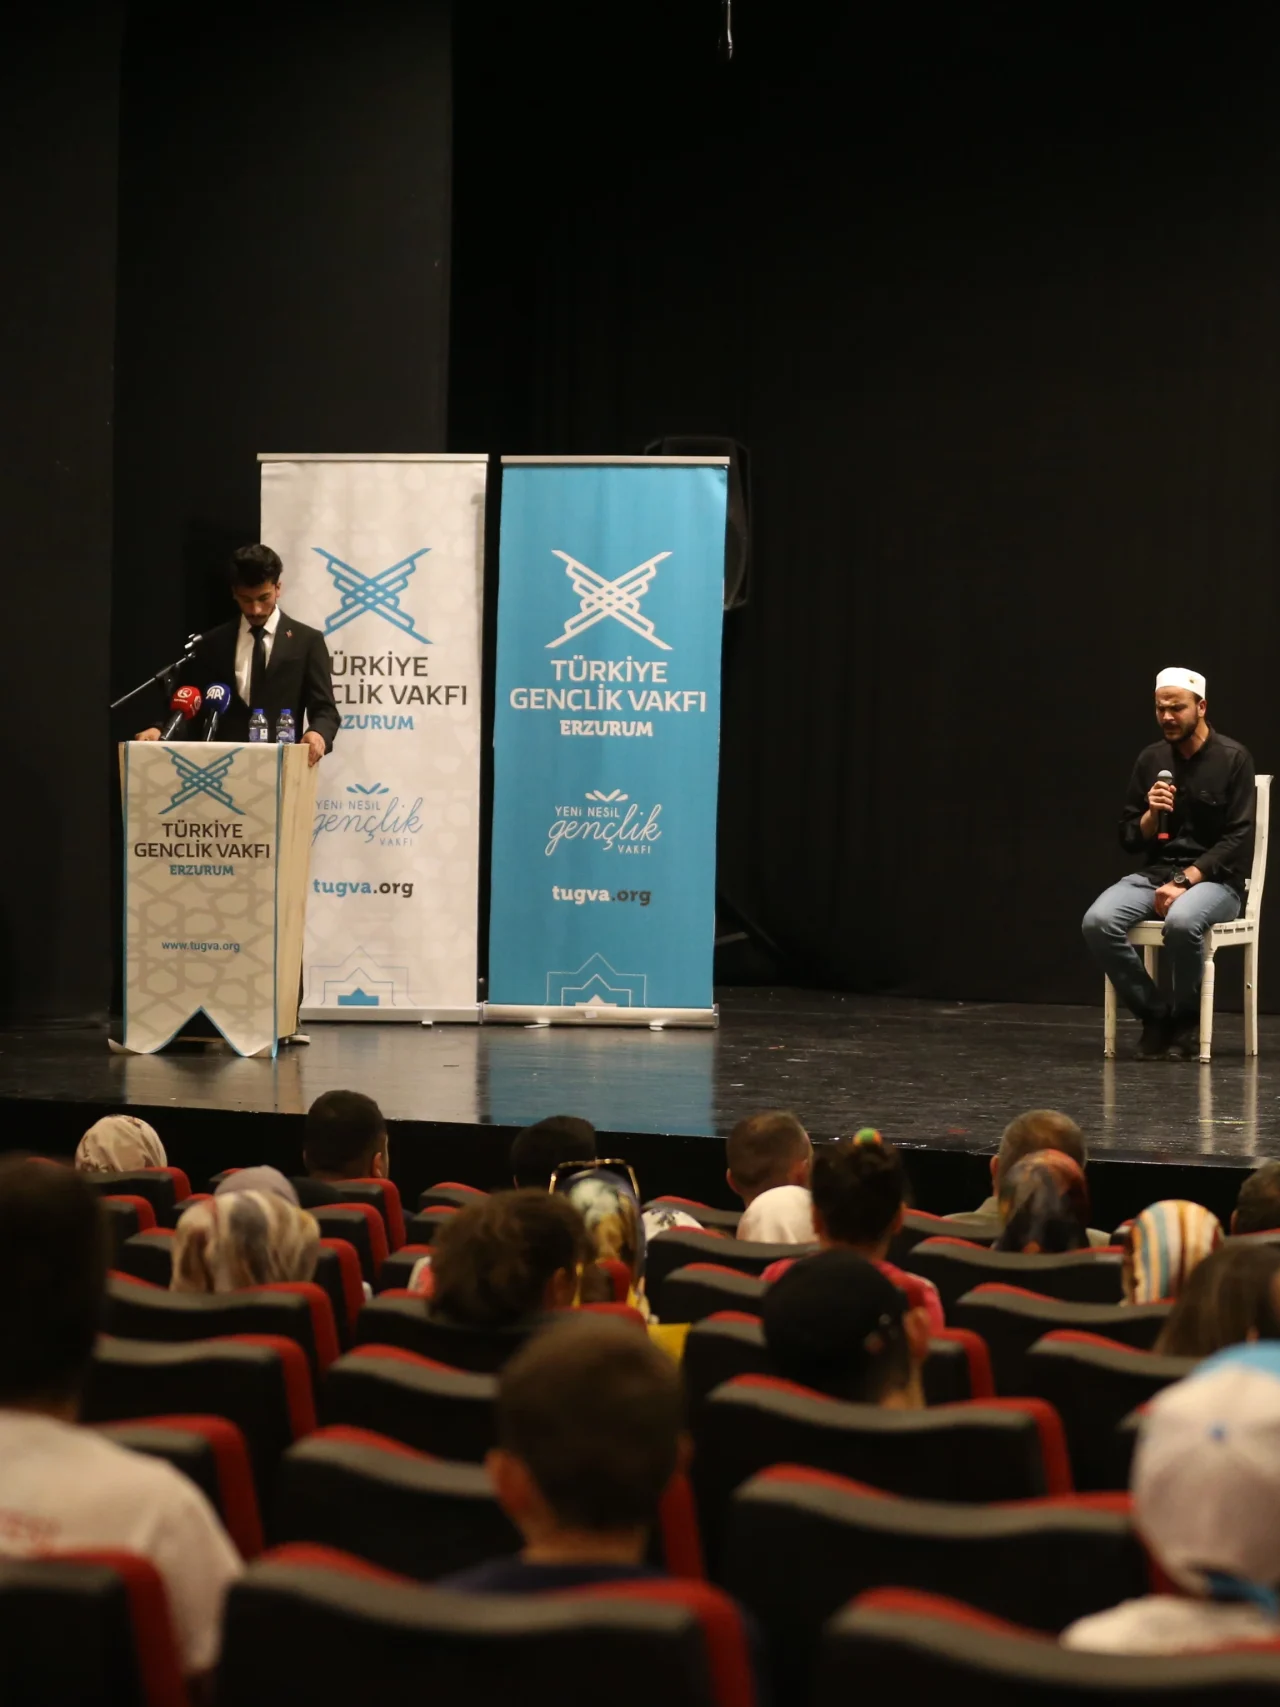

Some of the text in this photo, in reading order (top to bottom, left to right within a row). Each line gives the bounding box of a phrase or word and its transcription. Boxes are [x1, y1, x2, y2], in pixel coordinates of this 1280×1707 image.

[330, 651, 428, 677] ÜRKİYE
[550, 655, 668, 682] TÜRKİYE
[389, 685, 467, 705] VAKFI
[510, 684, 706, 712] GENÇLİK VAKFI
[560, 720, 653, 736] ERZURUM
[161, 820, 243, 838] TÜRKİYE
[545, 804, 662, 856] gençlik
[134, 840, 270, 858] GENÇLİK VAKFI
[618, 845, 651, 854] VAKFI
[169, 865, 235, 876] ERZURUM
[313, 879, 413, 898] tugva.org
[552, 886, 651, 906] tugva.org
[161, 941, 240, 953] www.tugva.org
